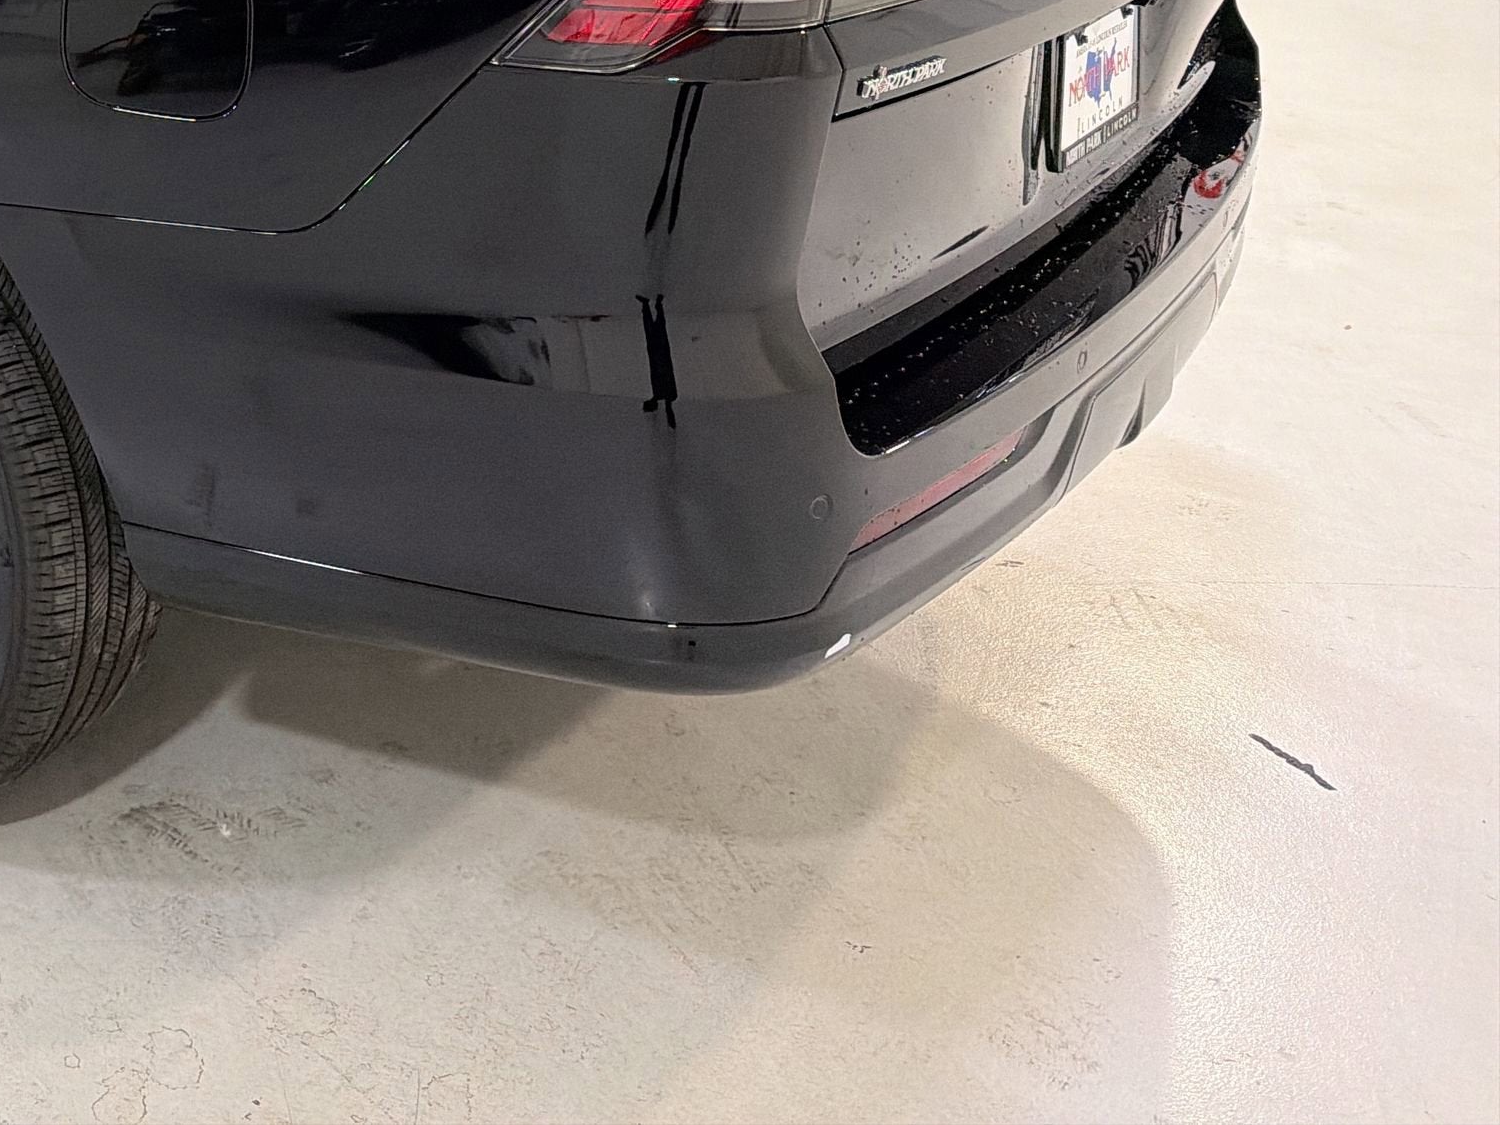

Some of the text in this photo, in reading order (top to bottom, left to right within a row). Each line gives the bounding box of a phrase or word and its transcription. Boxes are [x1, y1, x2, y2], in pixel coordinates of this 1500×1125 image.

[1069, 66, 1100, 107] NORTH
[1103, 45, 1131, 78] PARK
[1080, 96, 1123, 133] LINCOLN
[1107, 107, 1138, 138] LINCOLN
